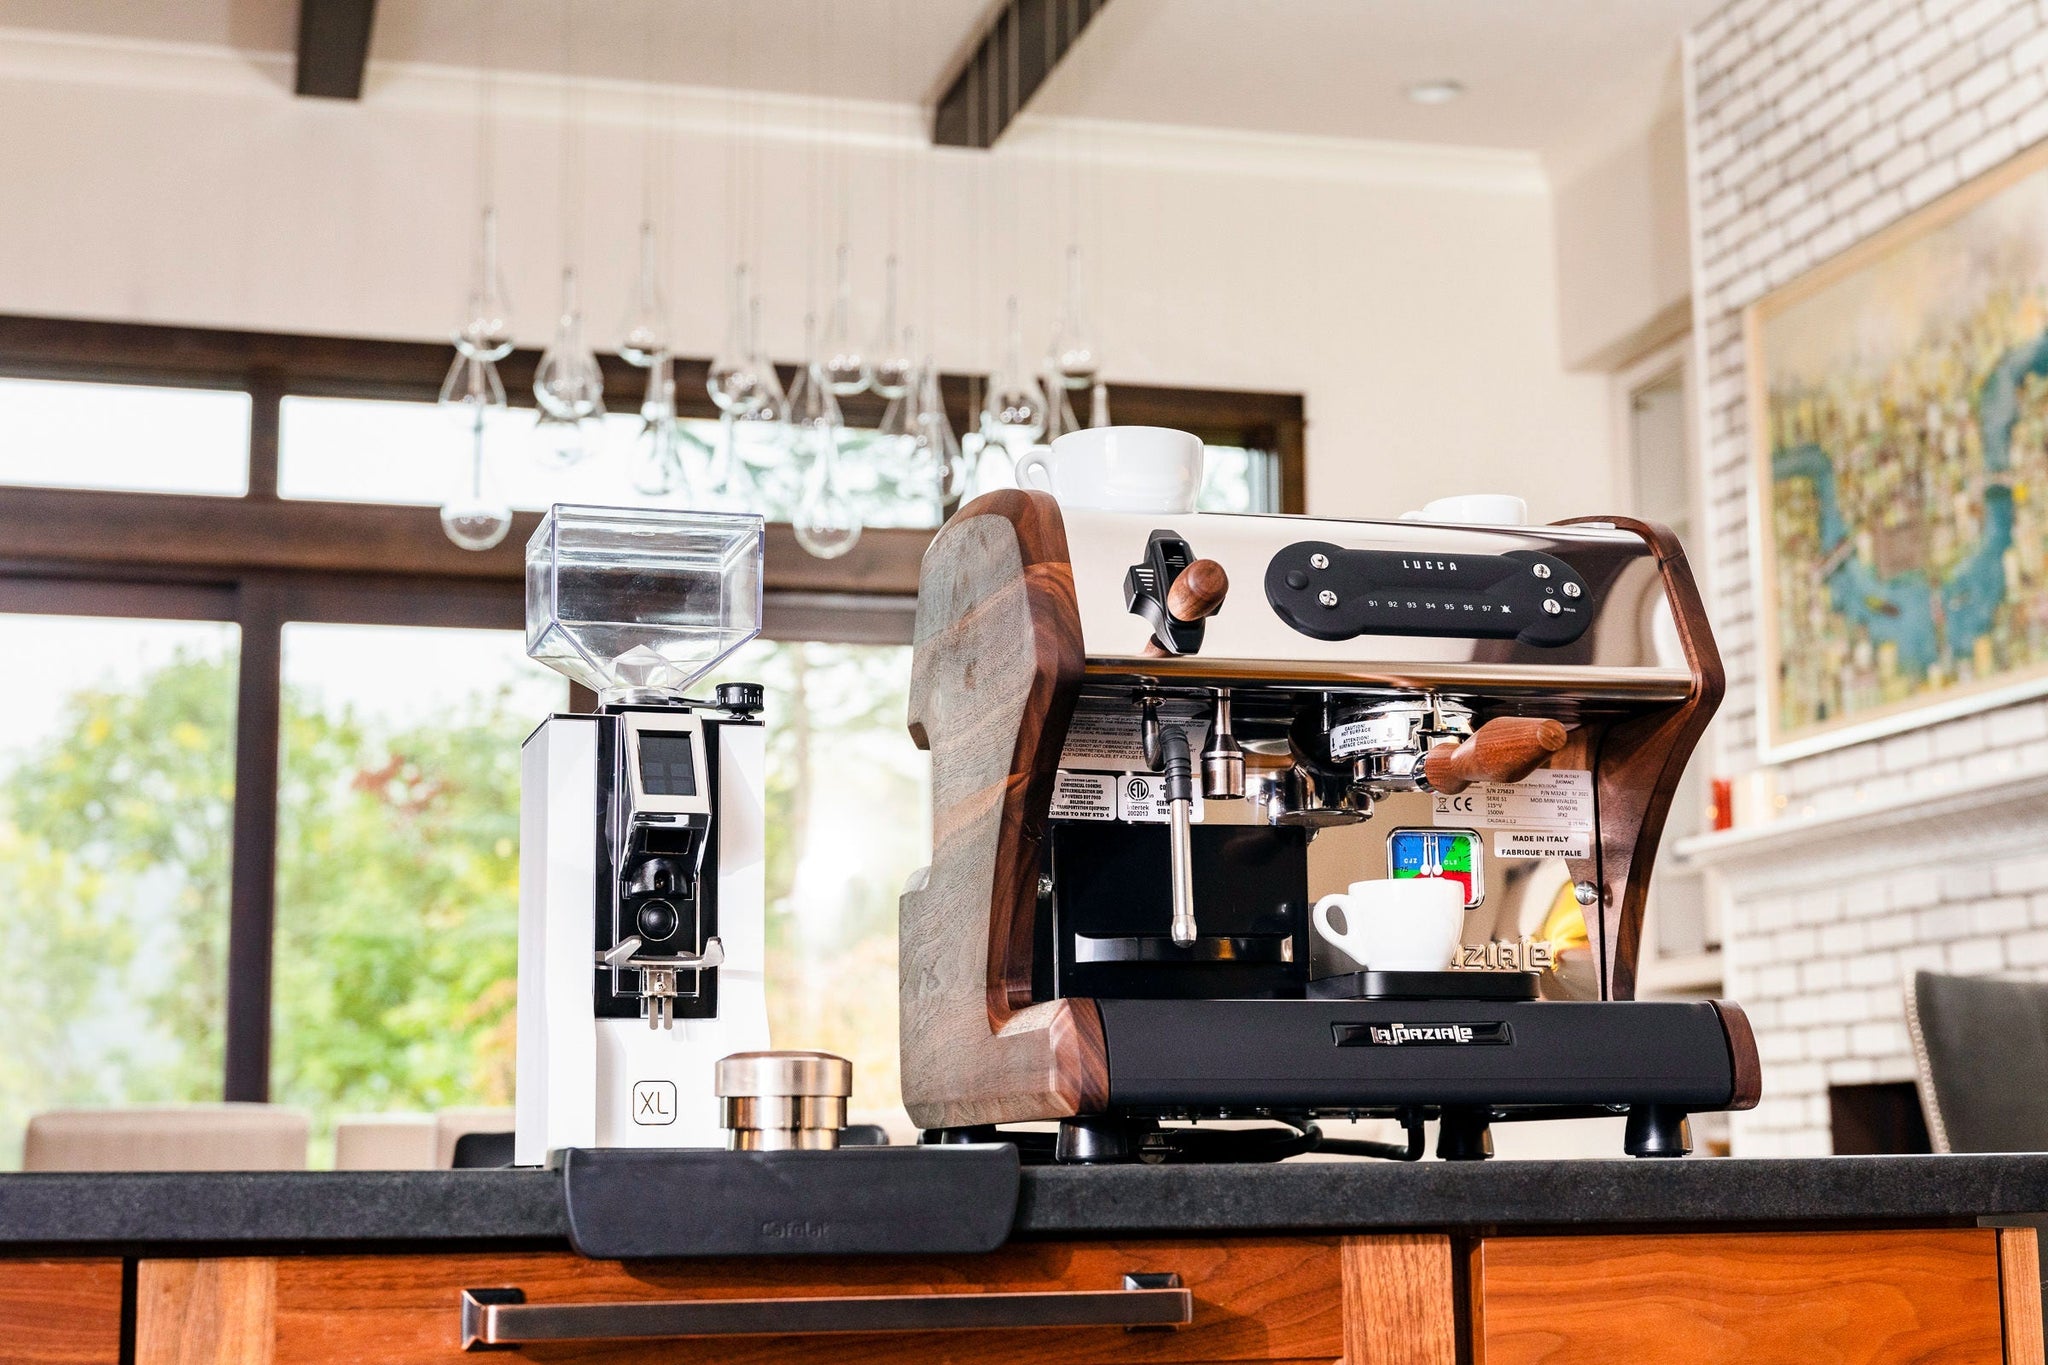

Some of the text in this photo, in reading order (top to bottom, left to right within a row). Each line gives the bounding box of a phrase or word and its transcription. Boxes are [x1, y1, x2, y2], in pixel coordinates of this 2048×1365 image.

[1403, 560, 1457, 571] LUCCA
[1387, 600, 1398, 608] 92
[1406, 601, 1417, 609] 93
[1454, 797, 1472, 811] CE
[640, 1091, 669, 1115] XL
